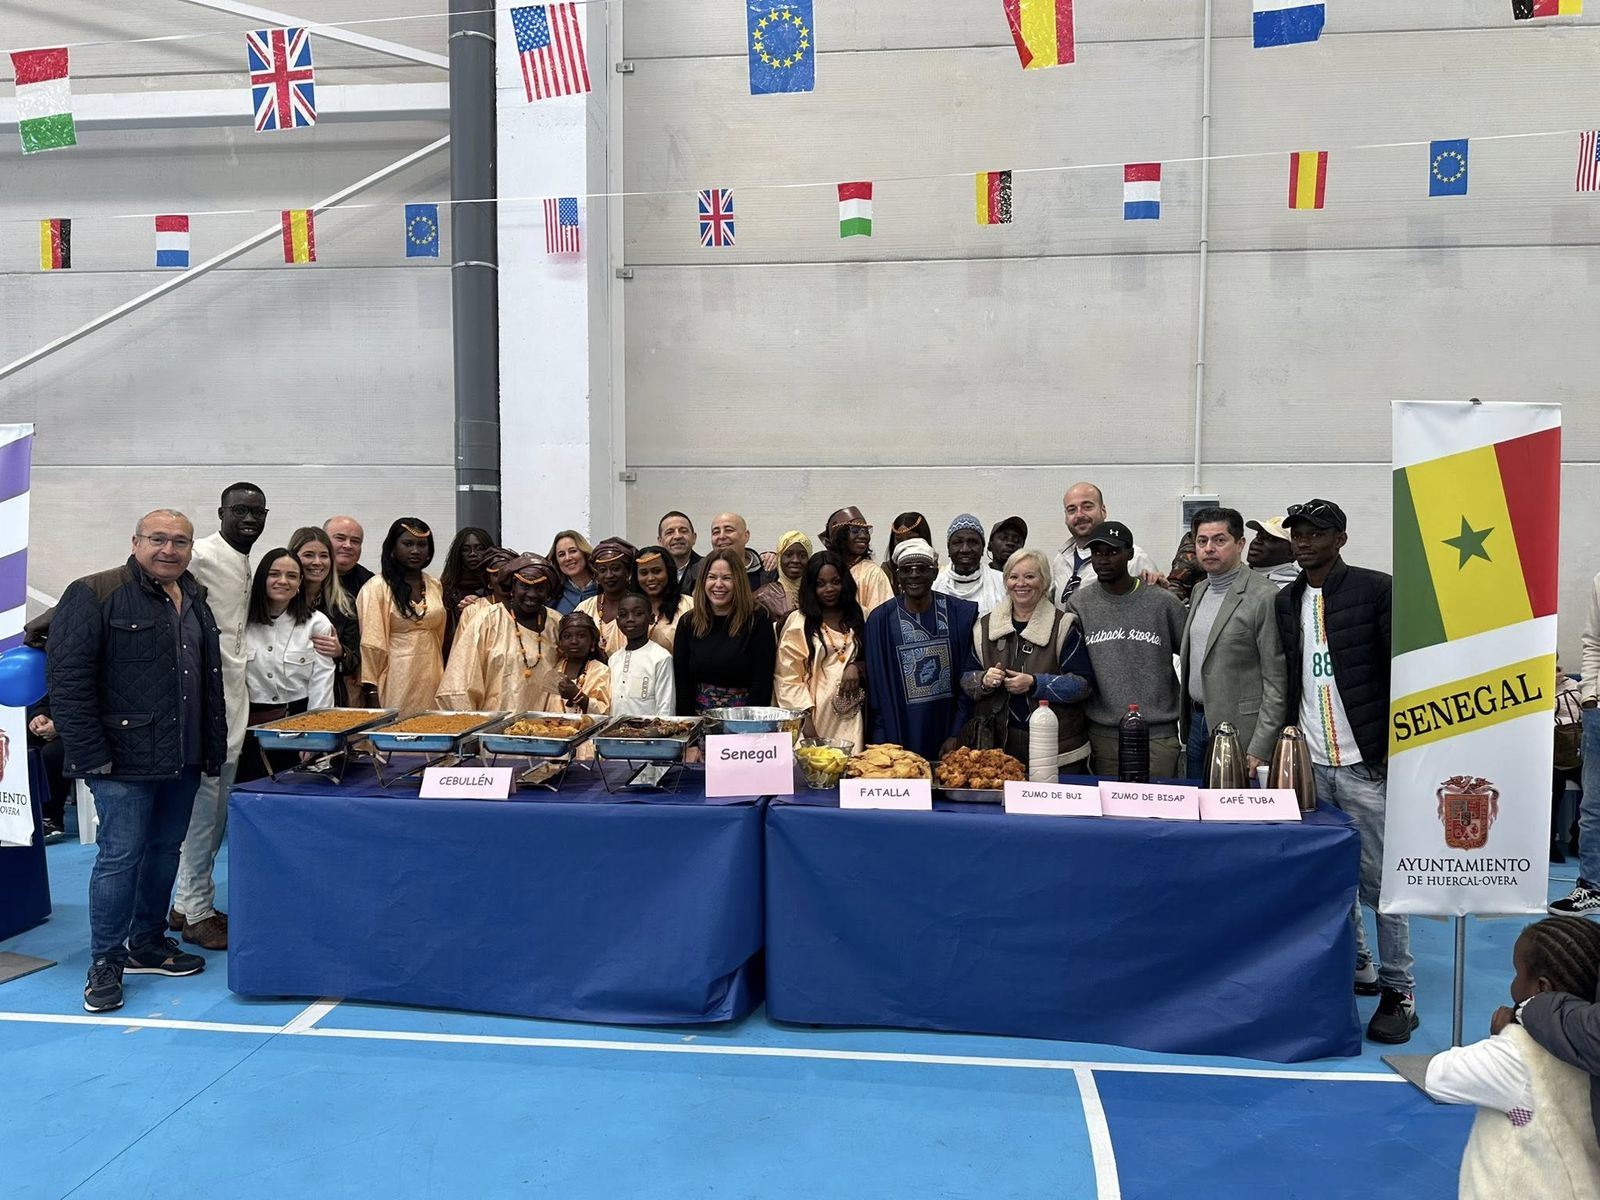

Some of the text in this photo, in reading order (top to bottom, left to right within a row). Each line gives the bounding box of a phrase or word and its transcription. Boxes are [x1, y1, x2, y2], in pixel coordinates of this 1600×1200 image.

[1085, 627, 1162, 646] aidback storie
[1312, 651, 1334, 677] 88
[1393, 673, 1543, 743] SENEGAL
[720, 746, 778, 763] Senegal
[439, 774, 494, 786] CEBULLÉN
[860, 788, 910, 798] FATALLA
[1021, 790, 1083, 800] ZUMO DE BUI
[1111, 792, 1186, 802] ZUMO DE BISAP
[1219, 794, 1275, 805] CAFÉ TUBA
[1396, 858, 1531, 872] AYUNTAMIENTO
[1407, 875, 1518, 886] DE HUERCAL-OVERA
